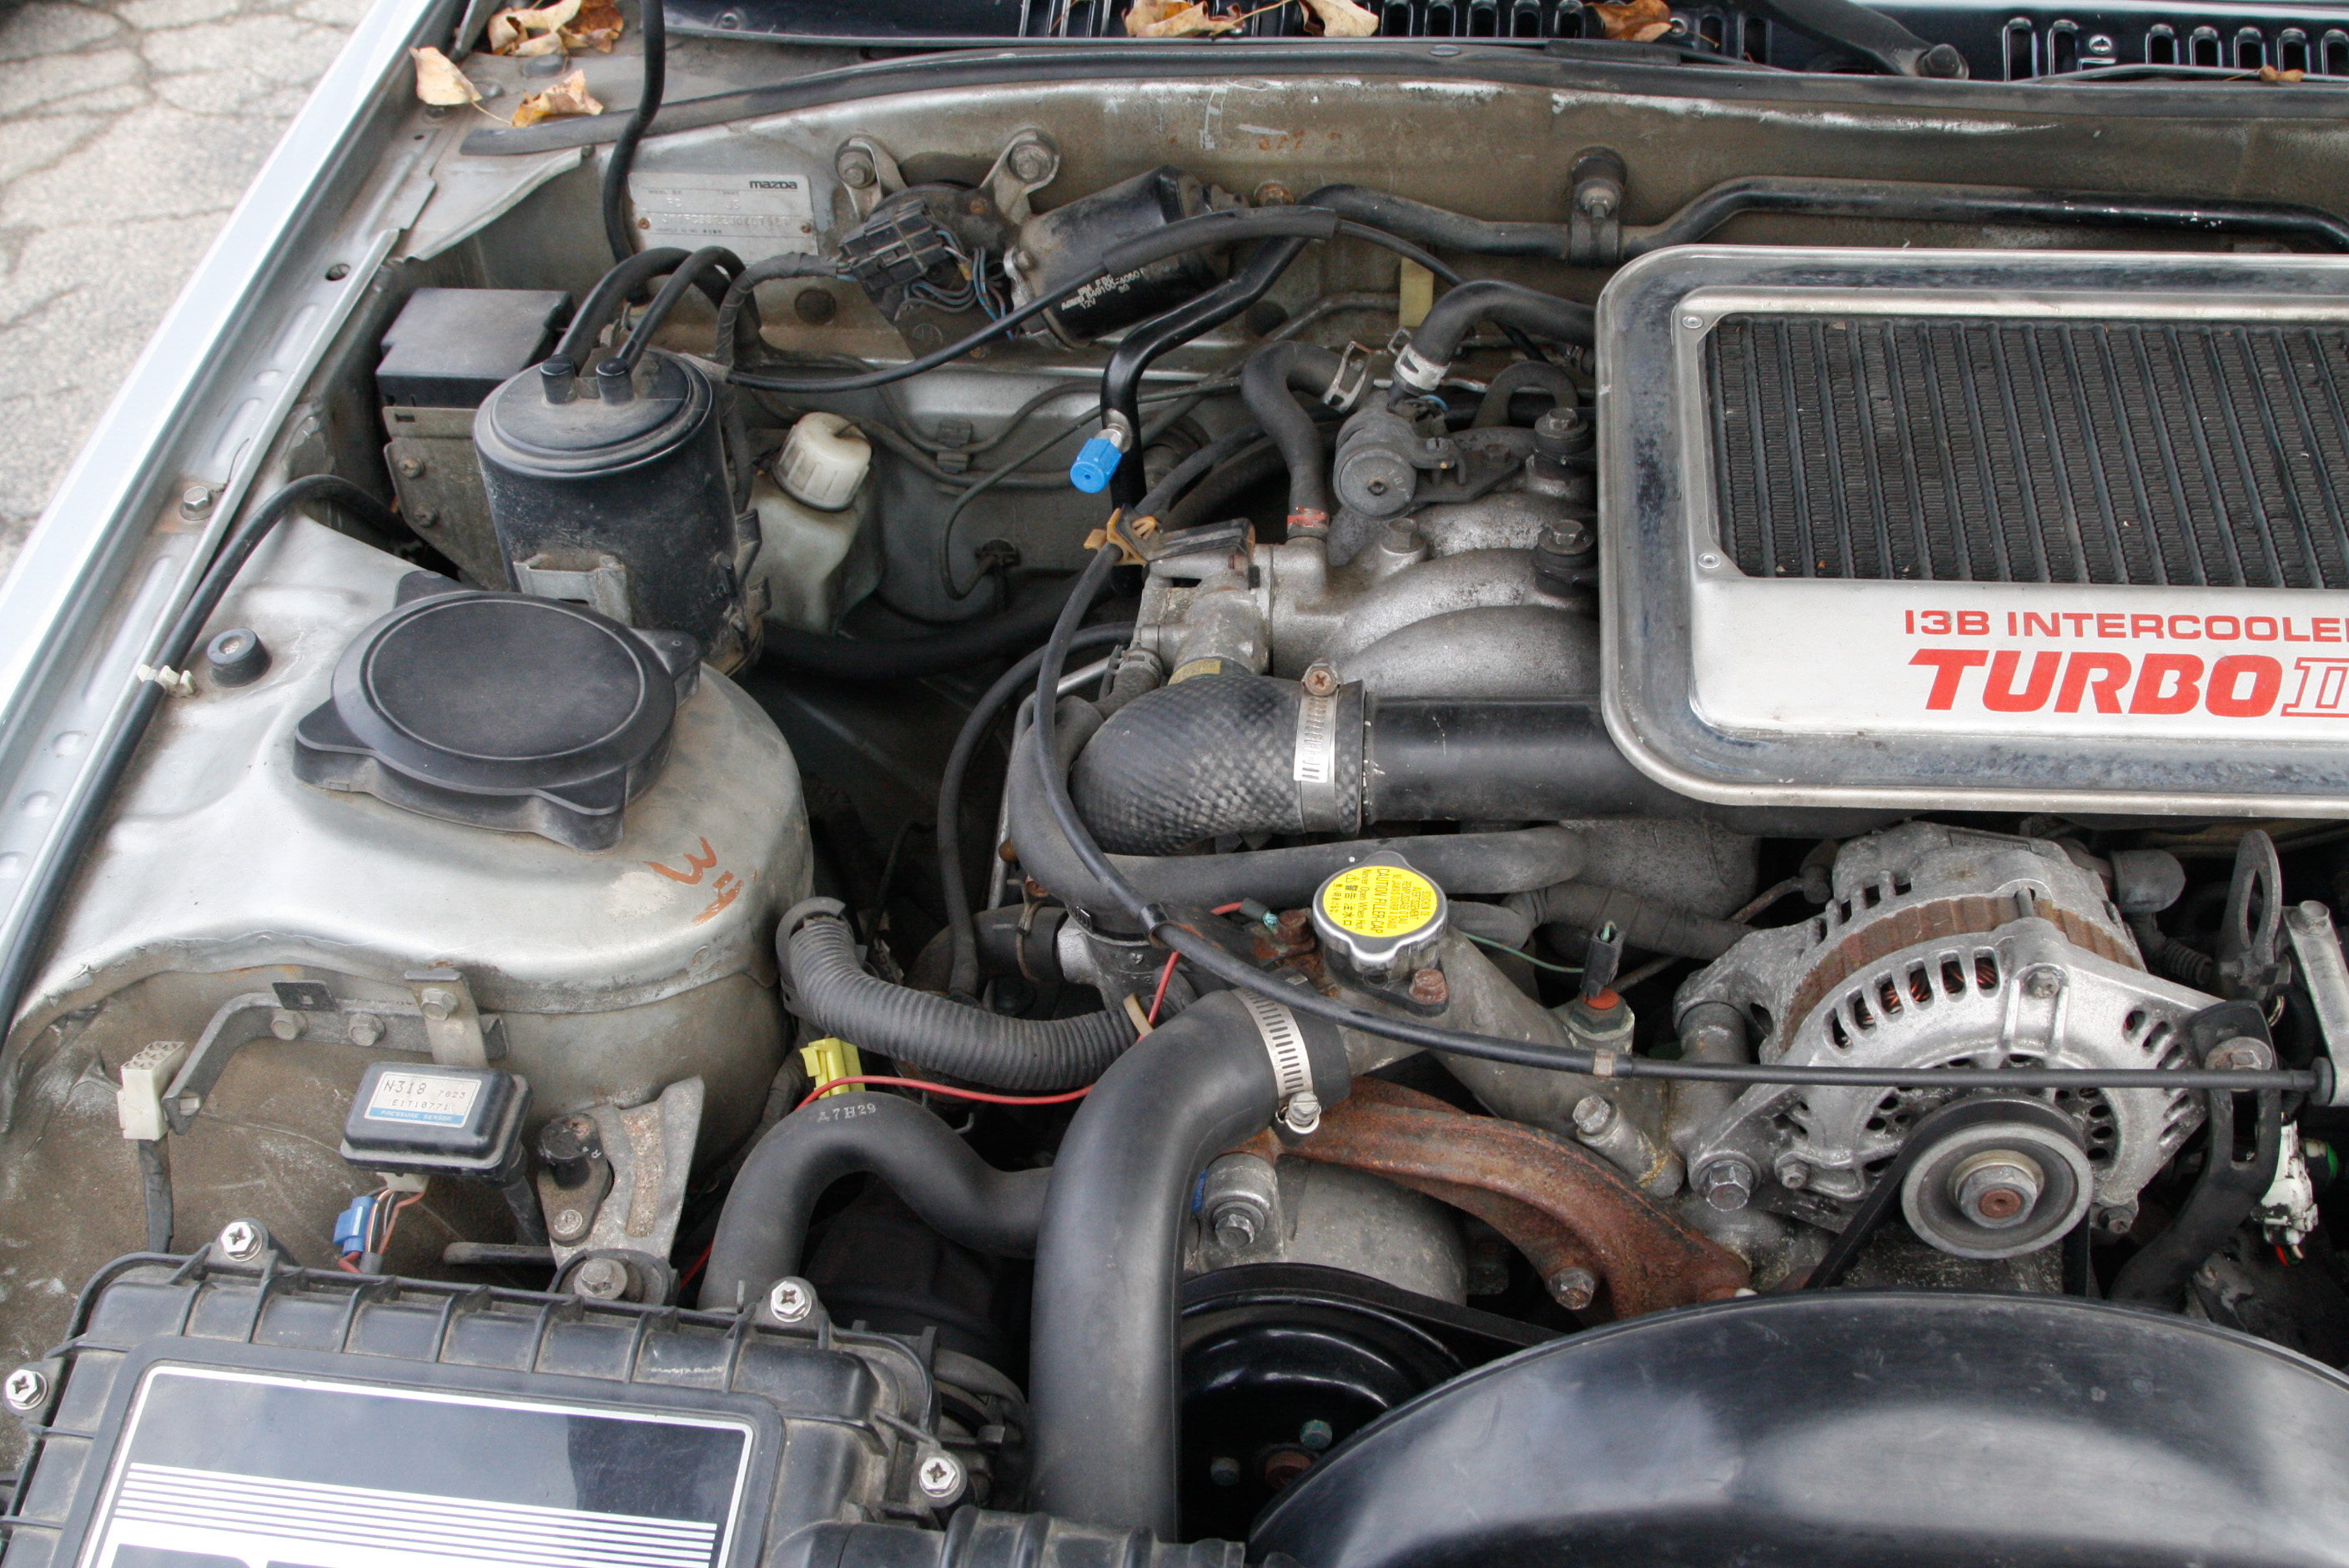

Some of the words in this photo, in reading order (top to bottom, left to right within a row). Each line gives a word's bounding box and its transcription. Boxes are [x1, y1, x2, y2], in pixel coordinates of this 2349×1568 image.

[2007, 611, 2349, 643] INTERCOOLE
[1908, 649, 2283, 717] TURBO
[1361, 869, 1371, 884] Never
[1375, 869, 1390, 897] CAUTION
[1359, 887, 1370, 900] Open
[1357, 902, 1368, 917] When
[1371, 898, 1386, 933] FILLER-CAP
[384, 1079, 427, 1095] N318
[437, 1089, 466, 1099] 7823
[380, 1110, 420, 1118] PRESSURE
